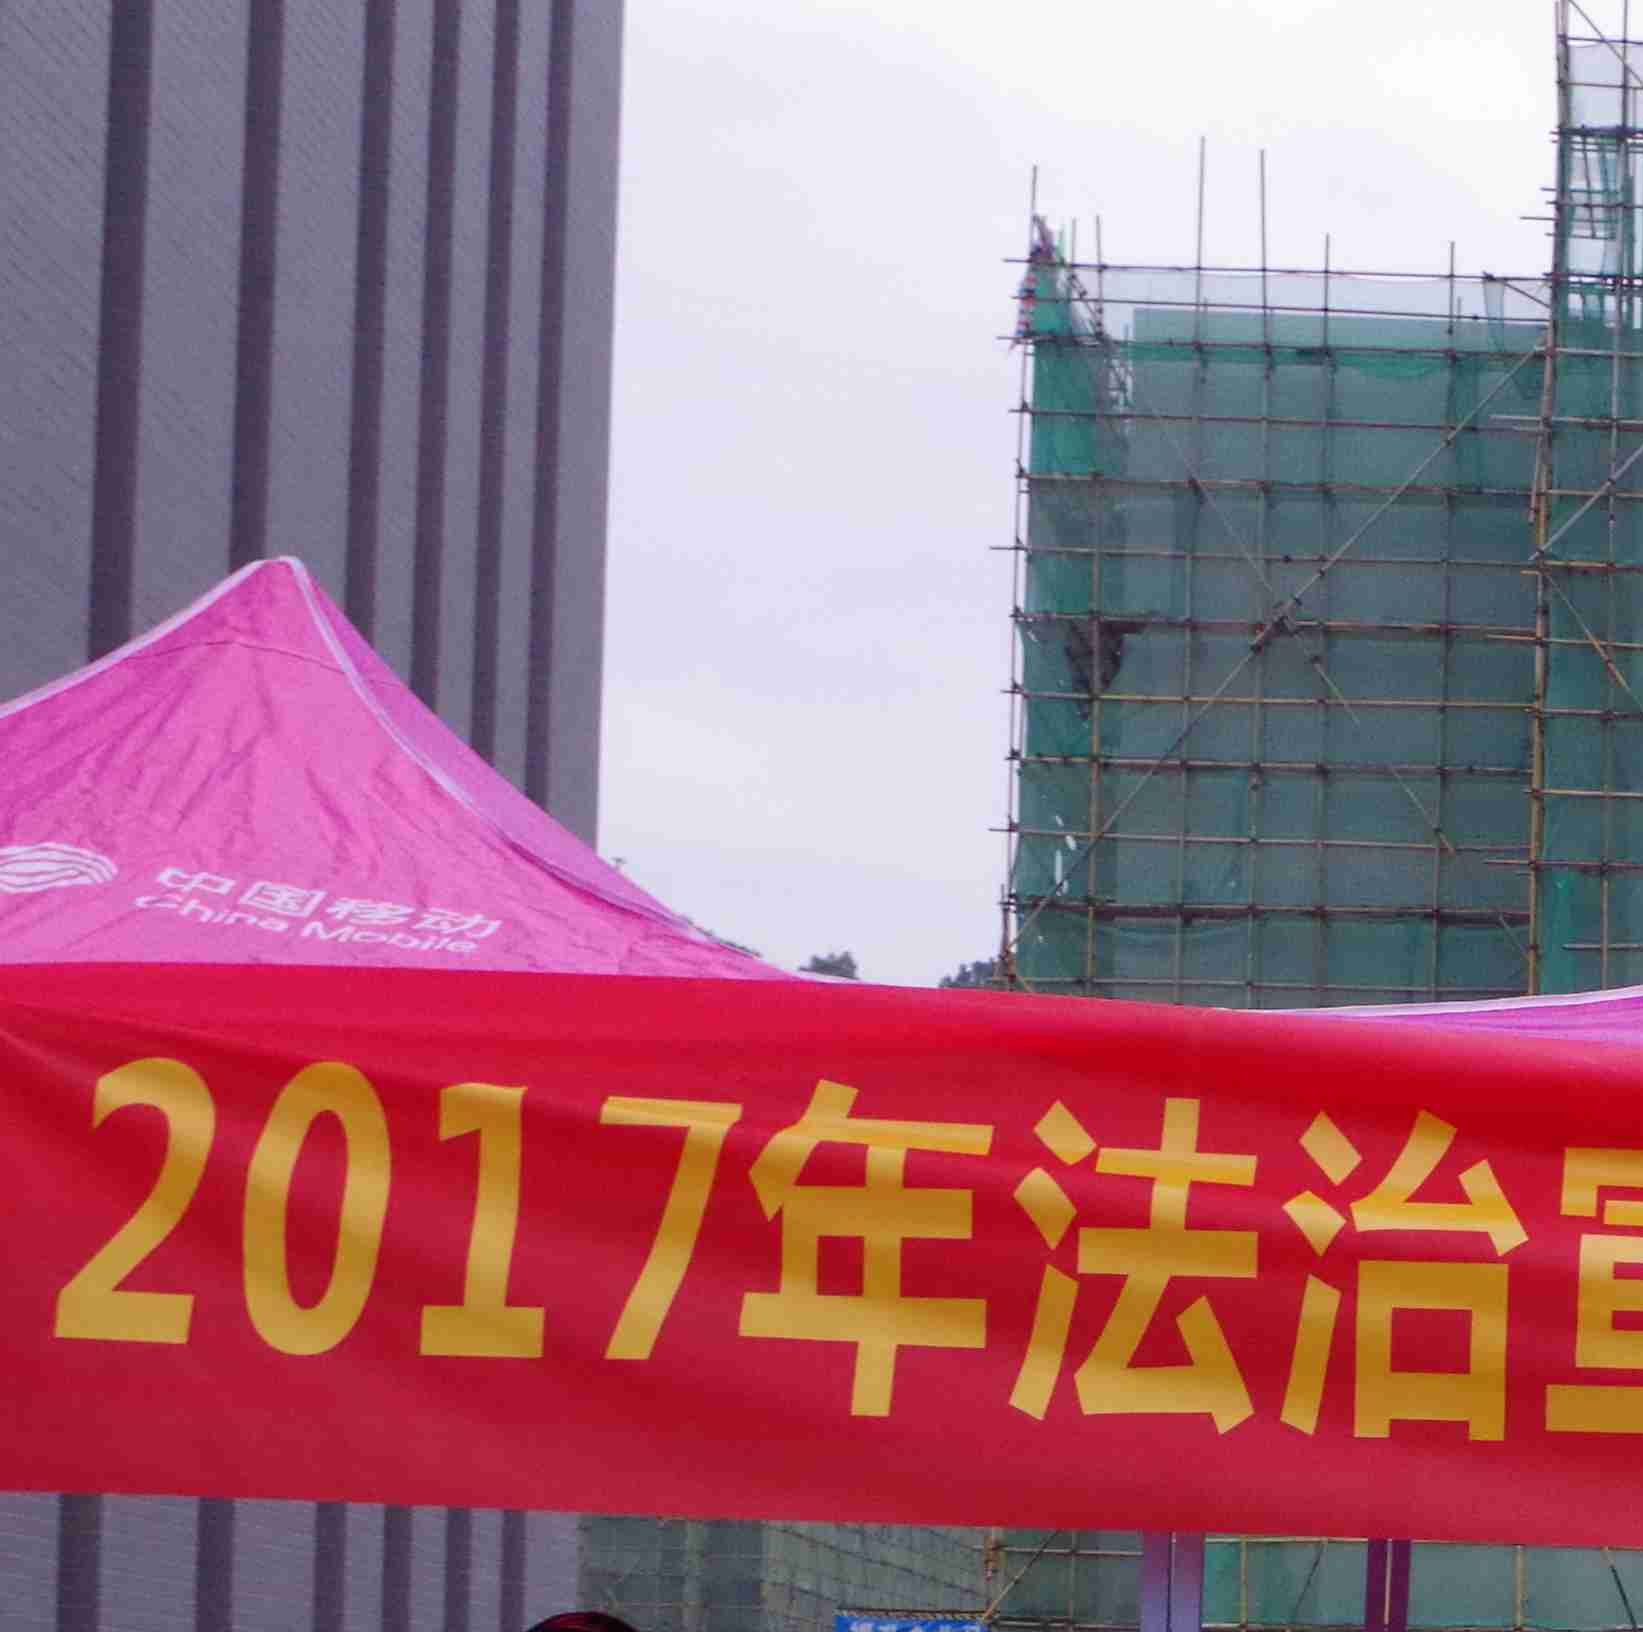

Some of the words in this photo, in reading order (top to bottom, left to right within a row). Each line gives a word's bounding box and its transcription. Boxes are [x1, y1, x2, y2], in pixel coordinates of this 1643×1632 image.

[130, 895, 290, 932] China
[302, 921, 479, 952] Mobile
[156, 867, 502, 938] 中国移动
